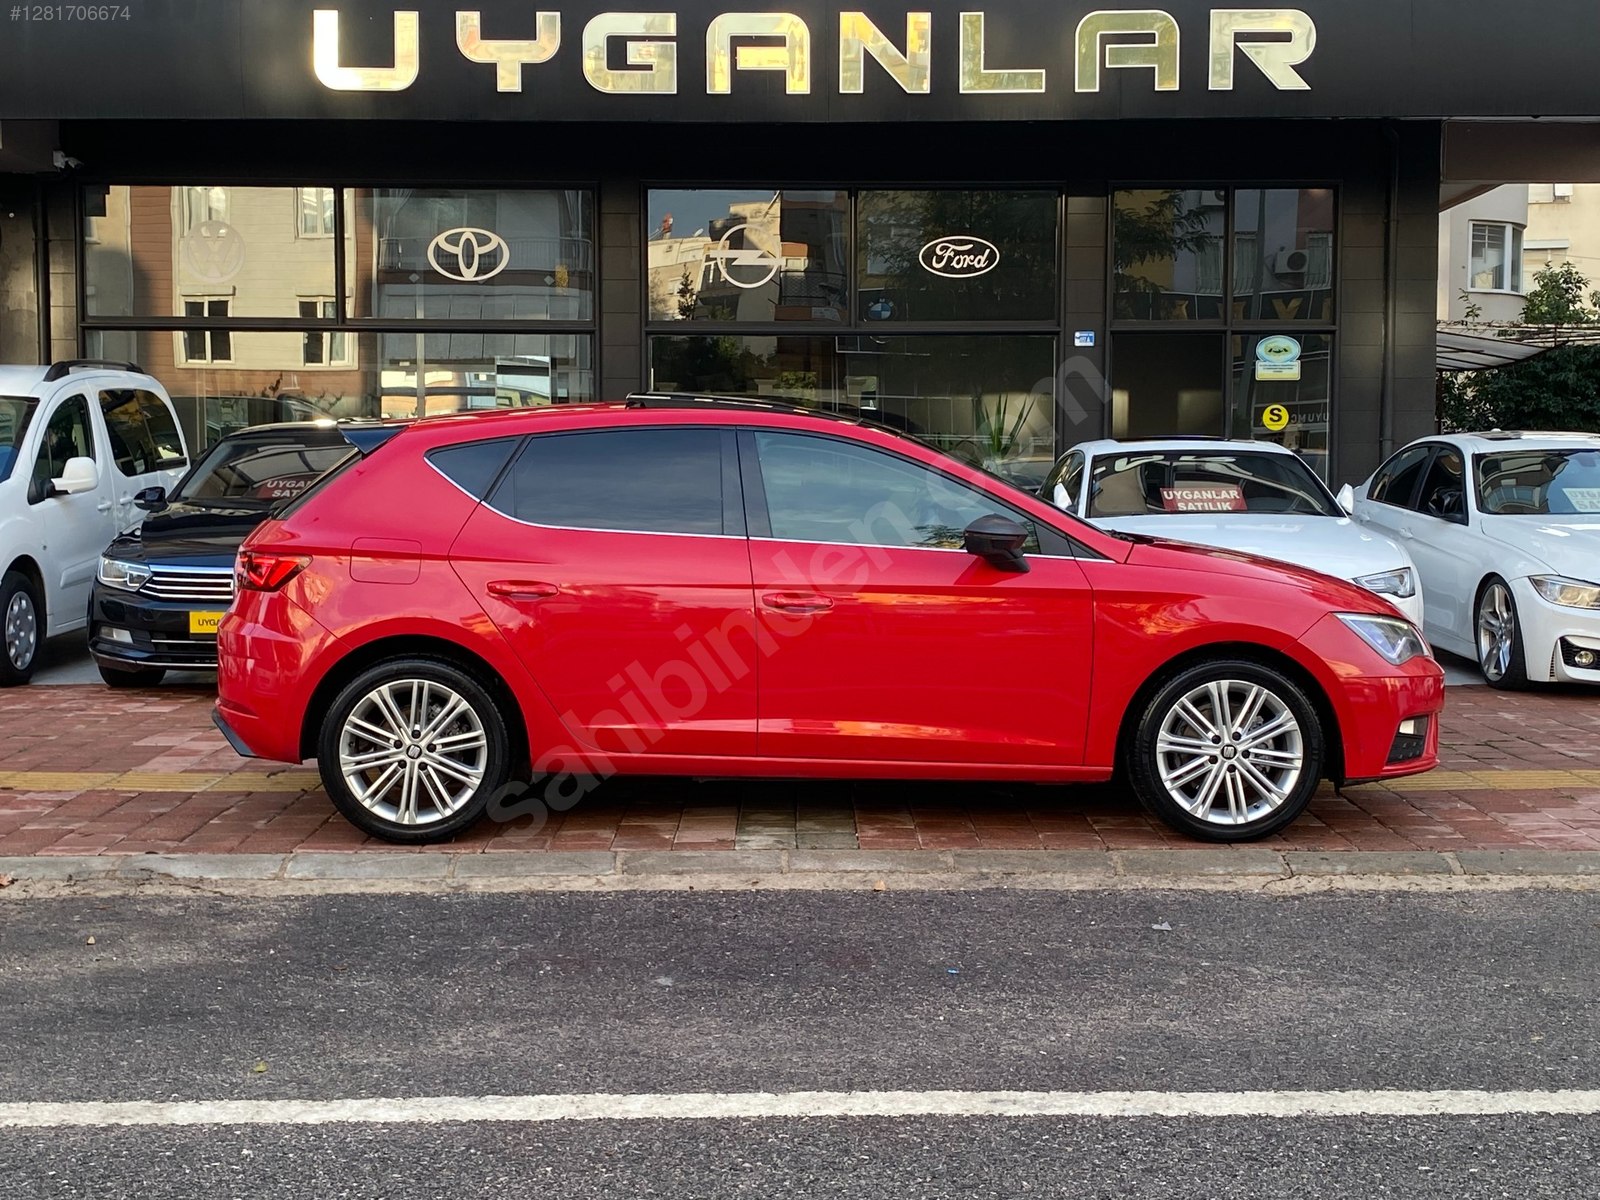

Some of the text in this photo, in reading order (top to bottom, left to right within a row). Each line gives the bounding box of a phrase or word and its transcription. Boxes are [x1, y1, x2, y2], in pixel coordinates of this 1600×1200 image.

[312, 9, 1318, 96] UYGANLAR
[932, 242, 990, 269] Ford
[1269, 407, 1283, 423] S
[1163, 490, 1240, 500] UYGANLAR
[1177, 501, 1233, 511] SATILIK
